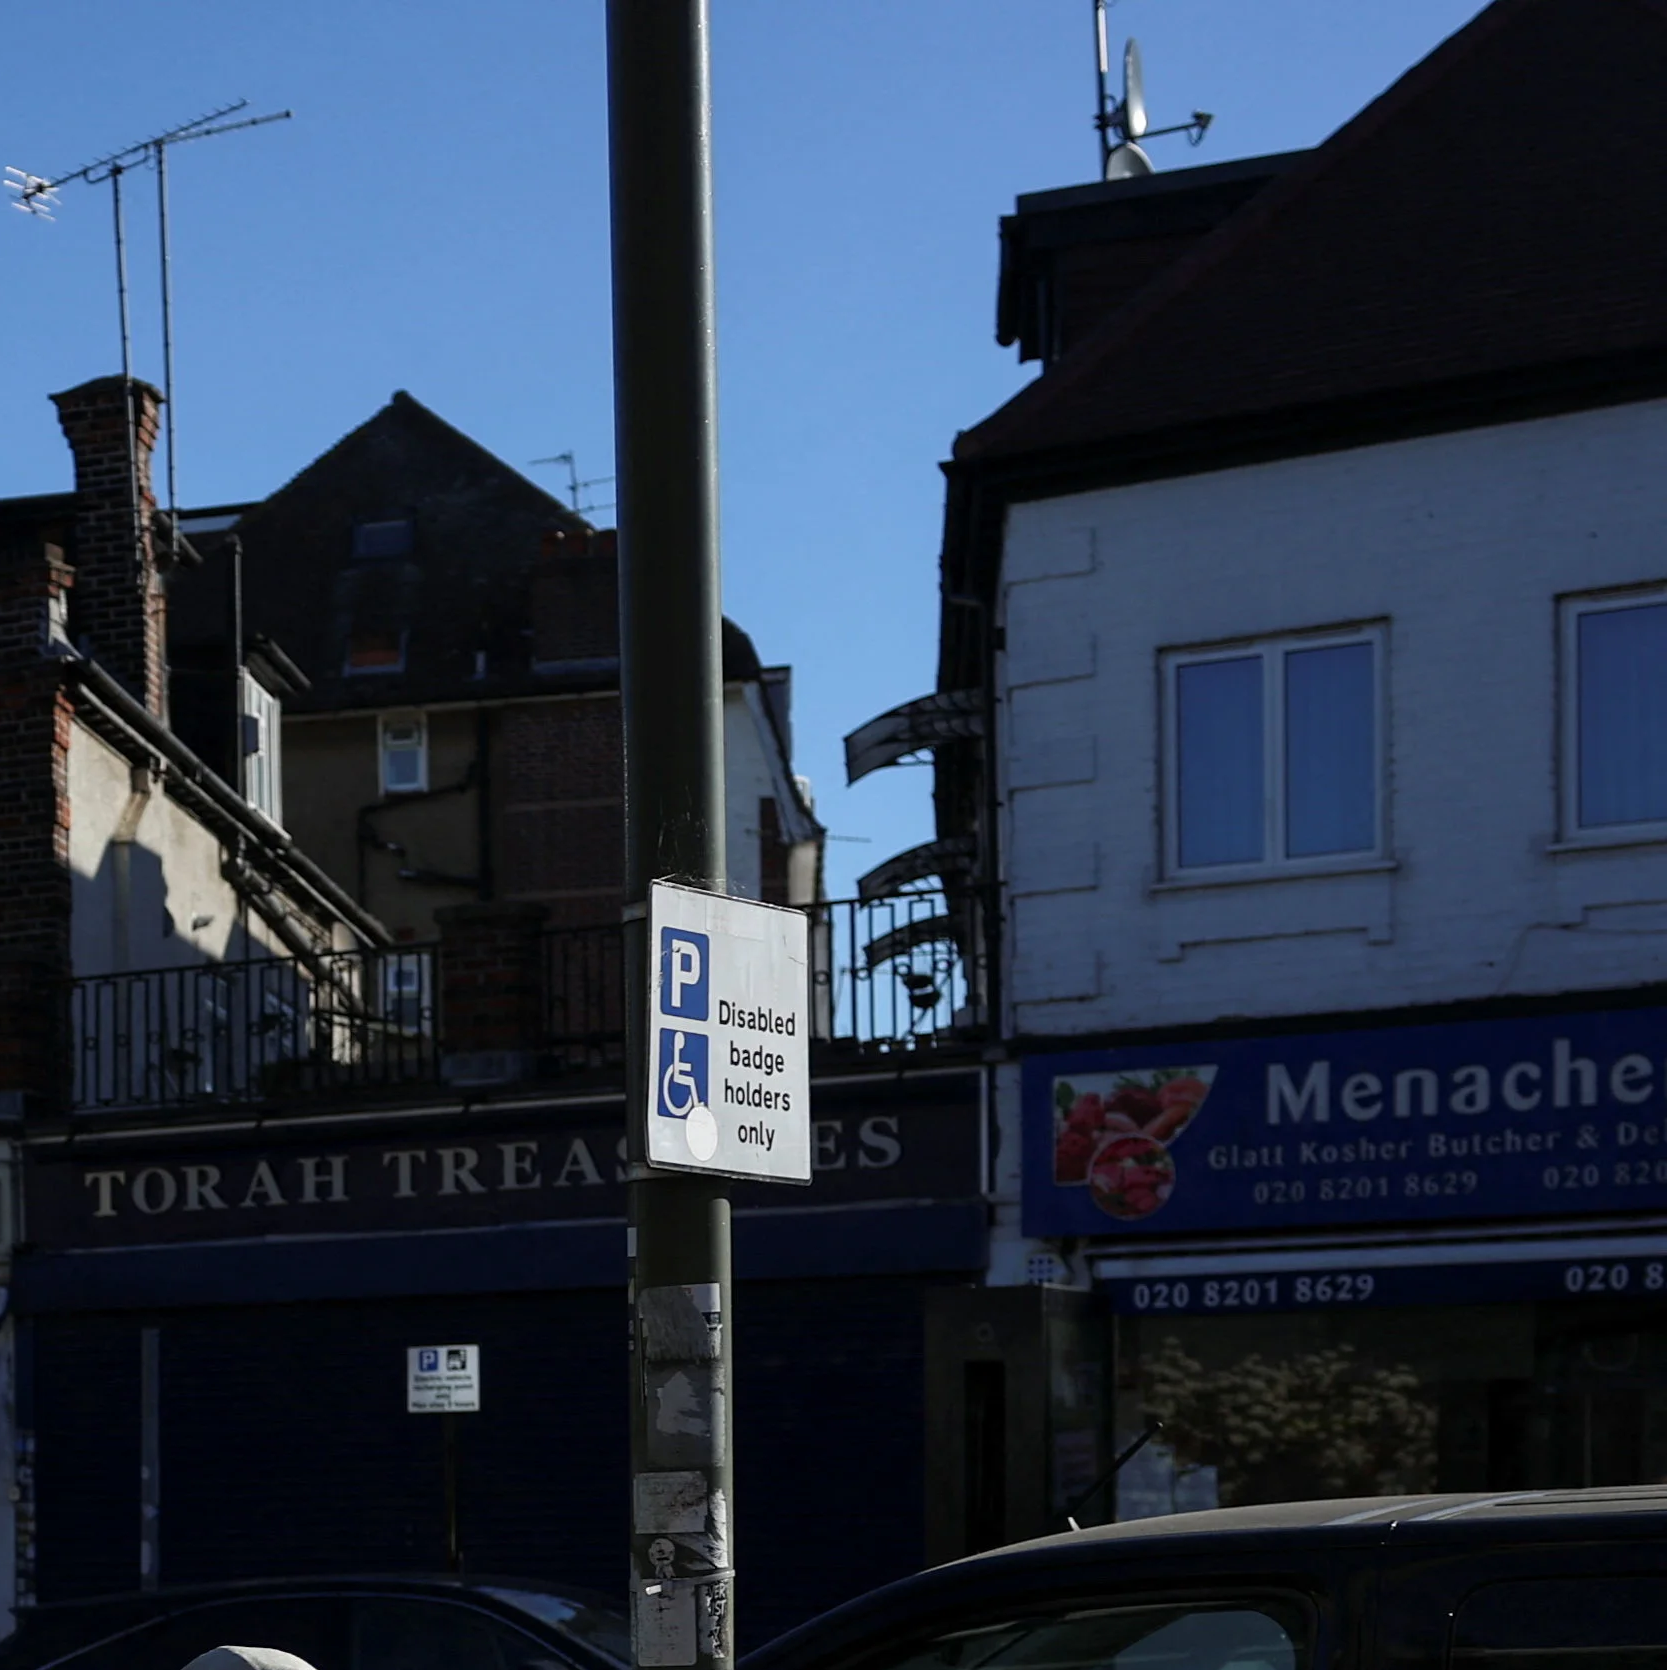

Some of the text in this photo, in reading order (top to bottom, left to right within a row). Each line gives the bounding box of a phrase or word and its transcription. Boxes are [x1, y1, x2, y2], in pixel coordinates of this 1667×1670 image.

[670, 939, 701, 1008] P
[719, 1000, 796, 1037] Disabled
[730, 1041, 785, 1076] badge
[724, 1079, 791, 1111] holders
[1267, 1037, 1667, 1126] Menache
[738, 1122, 775, 1152] only
[1208, 1144, 1284, 1170] Glatt
[1300, 1136, 1415, 1166] Kosher
[1429, 1126, 1561, 1158] Butcher
[1576, 1123, 1601, 1150] &
[84, 1156, 351, 1218] TORAH
[1254, 1169, 1478, 1205] 020 8201 8629
[1543, 1164, 1600, 1190] 020
[1132, 1274, 1376, 1309] 020 8201 8629
[1564, 1264, 1627, 1293] 020
